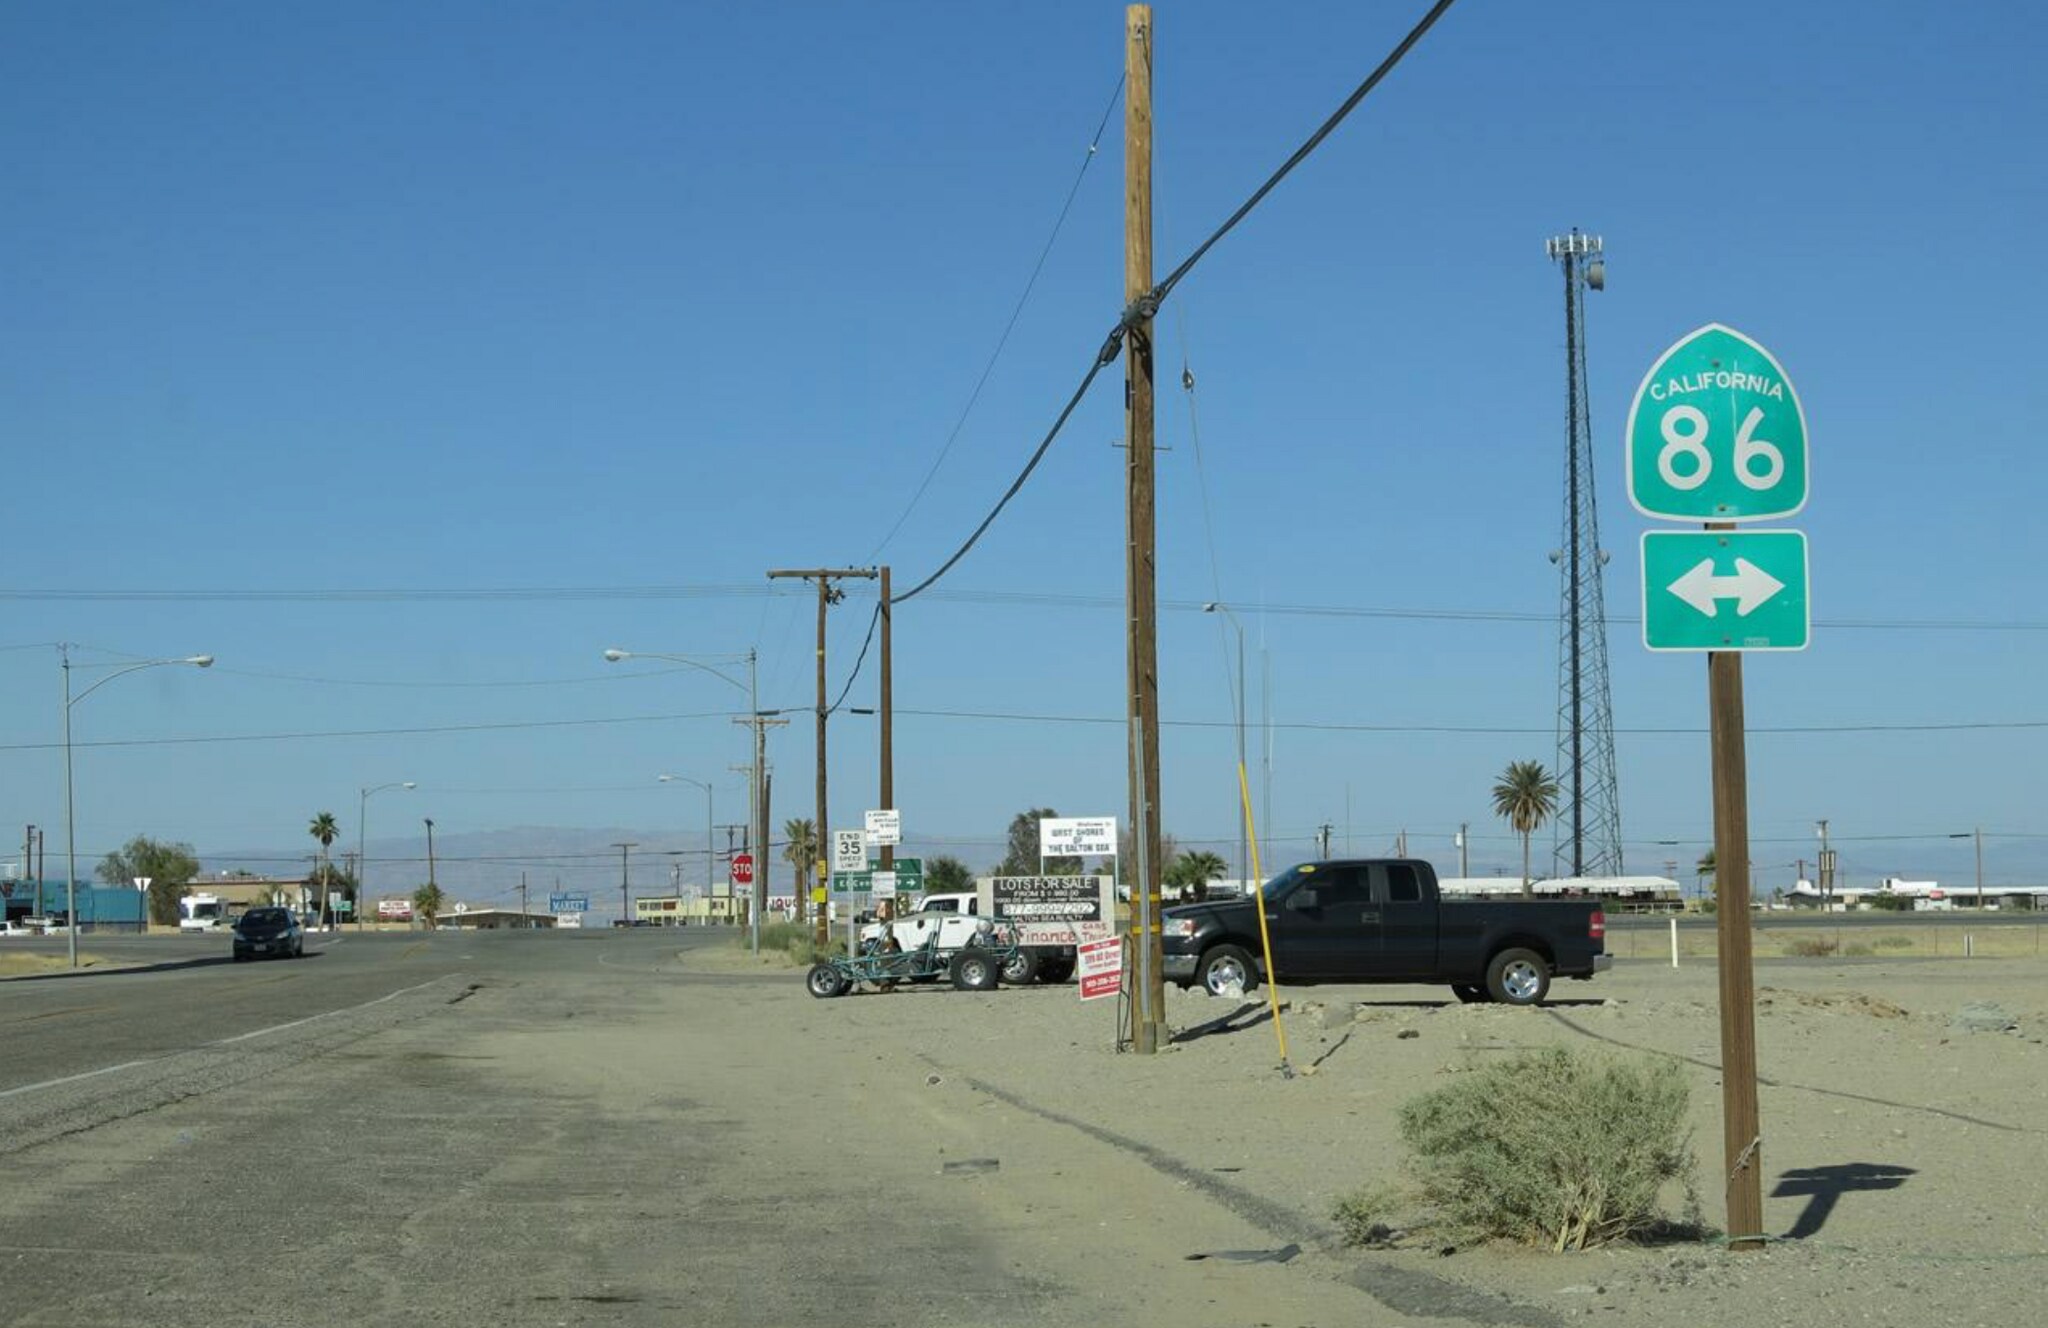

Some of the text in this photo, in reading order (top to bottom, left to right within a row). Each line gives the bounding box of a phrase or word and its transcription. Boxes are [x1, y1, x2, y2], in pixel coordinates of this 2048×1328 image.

[1650, 371, 1783, 402] CALIFORNIA
[1657, 404, 1785, 490] 86
[839, 832, 860, 840] END
[840, 841, 860, 855] 35
[733, 863, 752, 875] STO
[1000, 877, 1092, 891] LOTS FOR SALE
[1017, 924, 1076, 943] Finance
